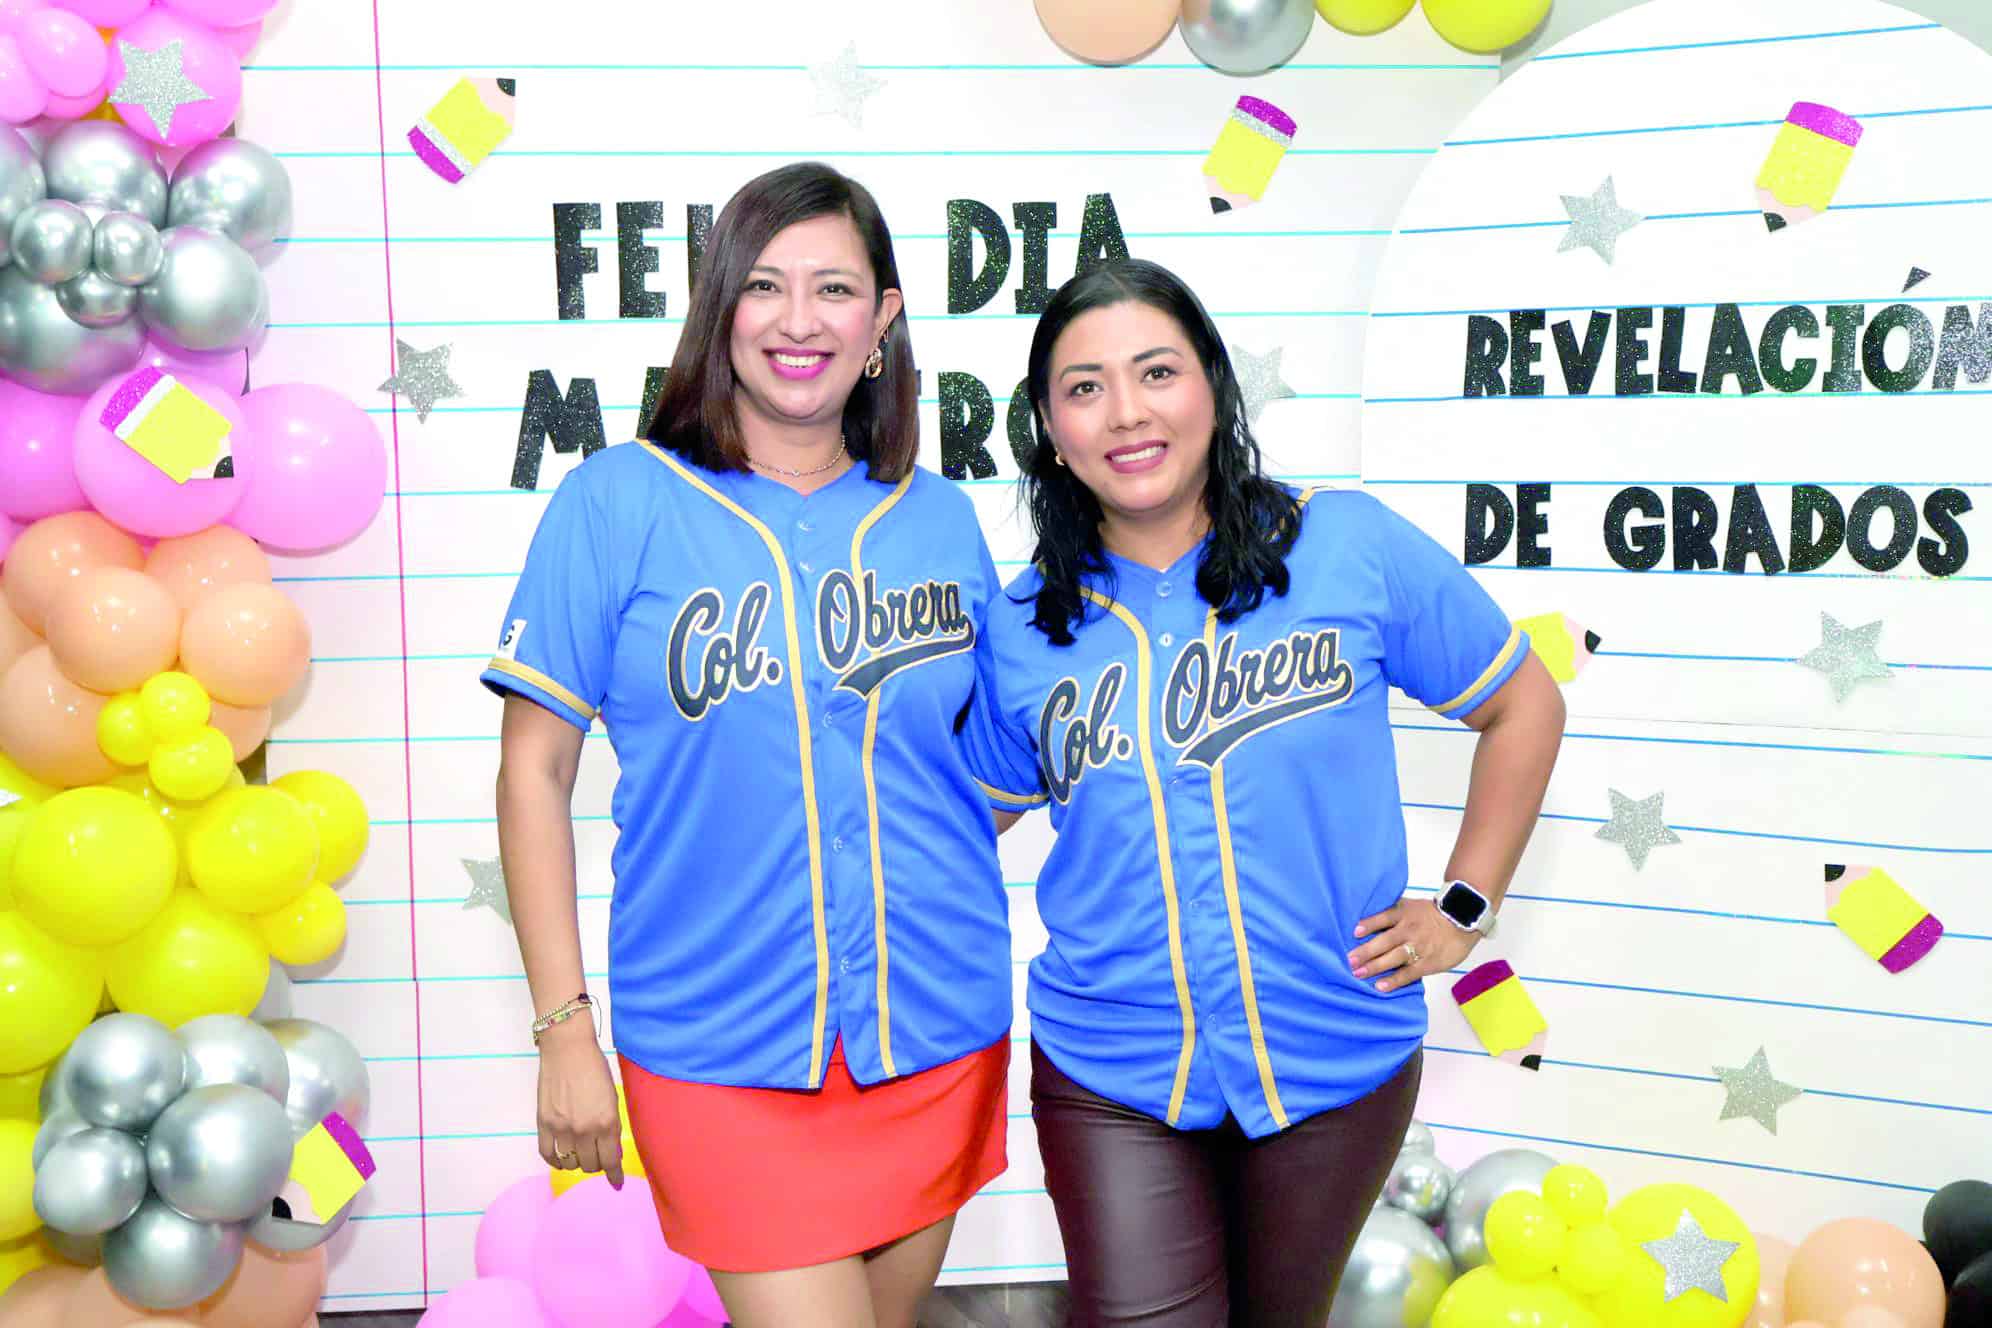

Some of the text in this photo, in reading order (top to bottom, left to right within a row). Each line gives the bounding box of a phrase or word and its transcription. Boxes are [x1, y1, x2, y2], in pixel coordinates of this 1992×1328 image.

[947, 192, 1131, 314] DIA
[1463, 266, 1992, 398] REVELACIÓN
[1464, 483, 1974, 576] DE GRADOS
[668, 568, 976, 722] Col. Obrera
[1039, 628, 1353, 805] Col. Obrera
